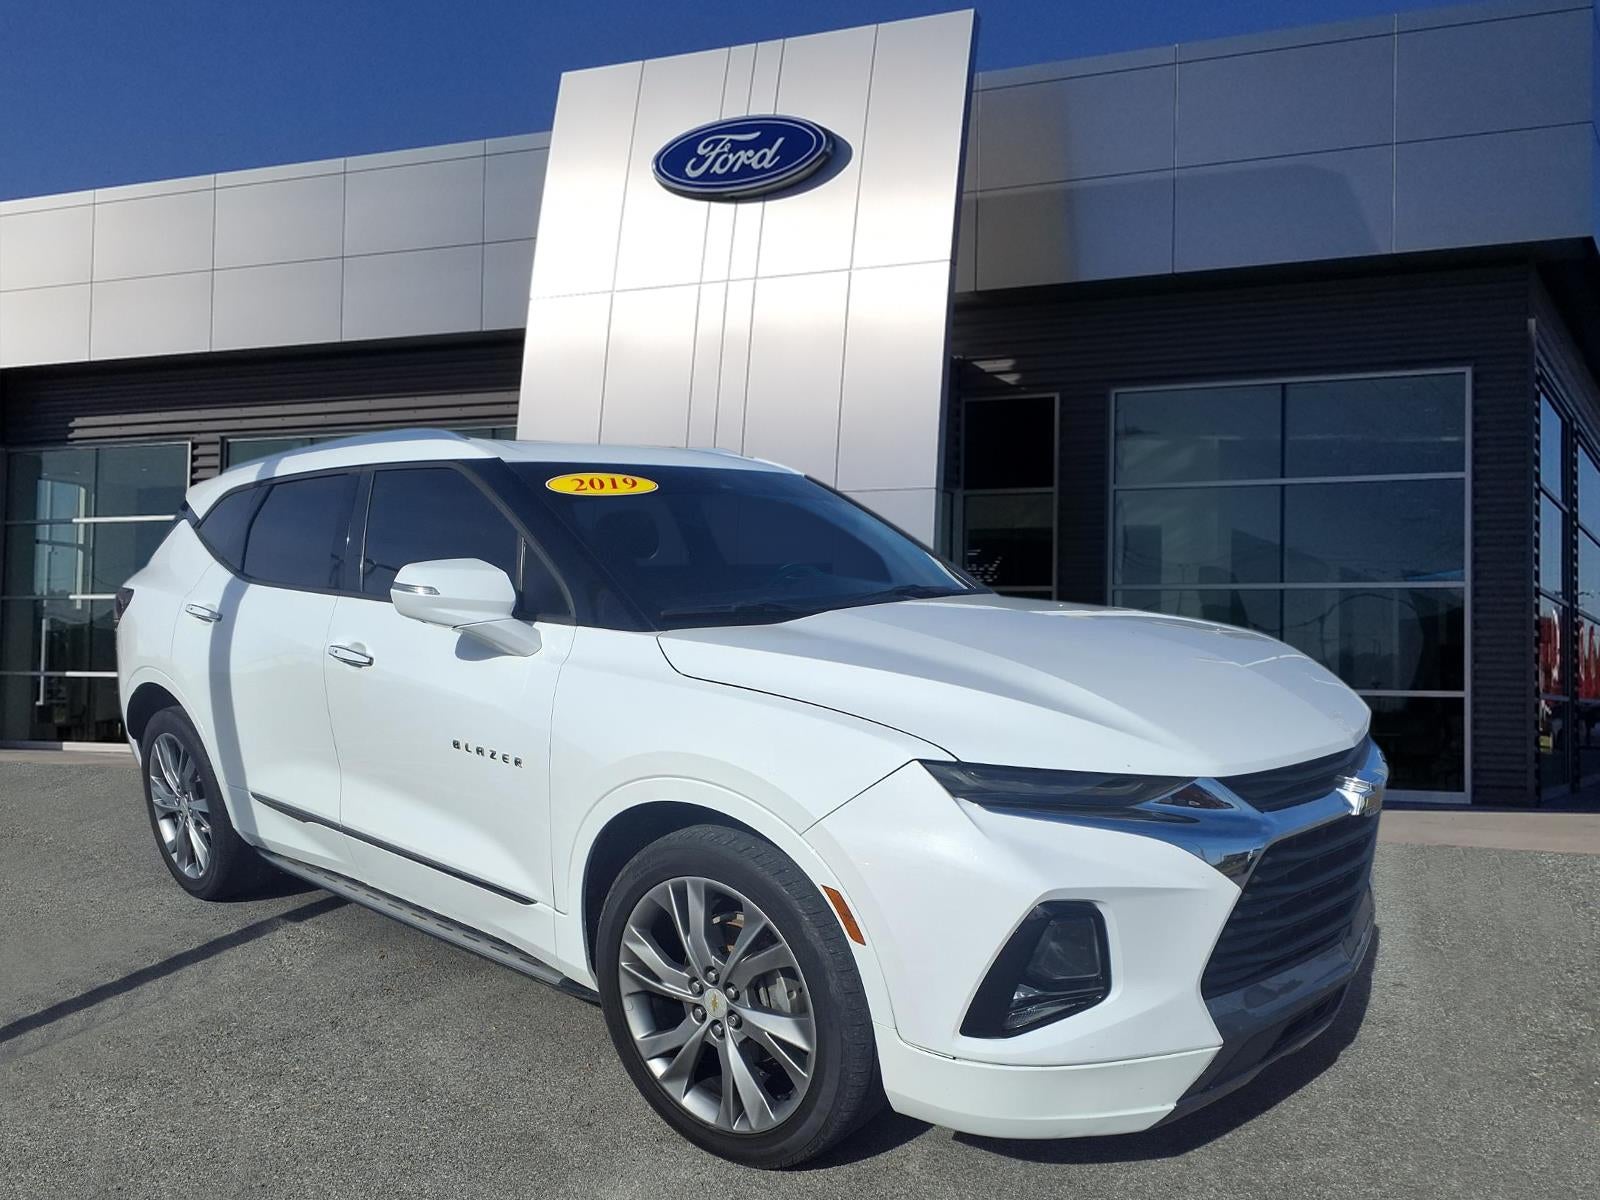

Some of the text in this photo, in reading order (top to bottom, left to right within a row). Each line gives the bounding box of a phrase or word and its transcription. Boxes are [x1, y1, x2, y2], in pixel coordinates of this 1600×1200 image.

[685, 131, 784, 177] Ford
[571, 477, 638, 491] 2019
[452, 739, 523, 768] BLAZER
